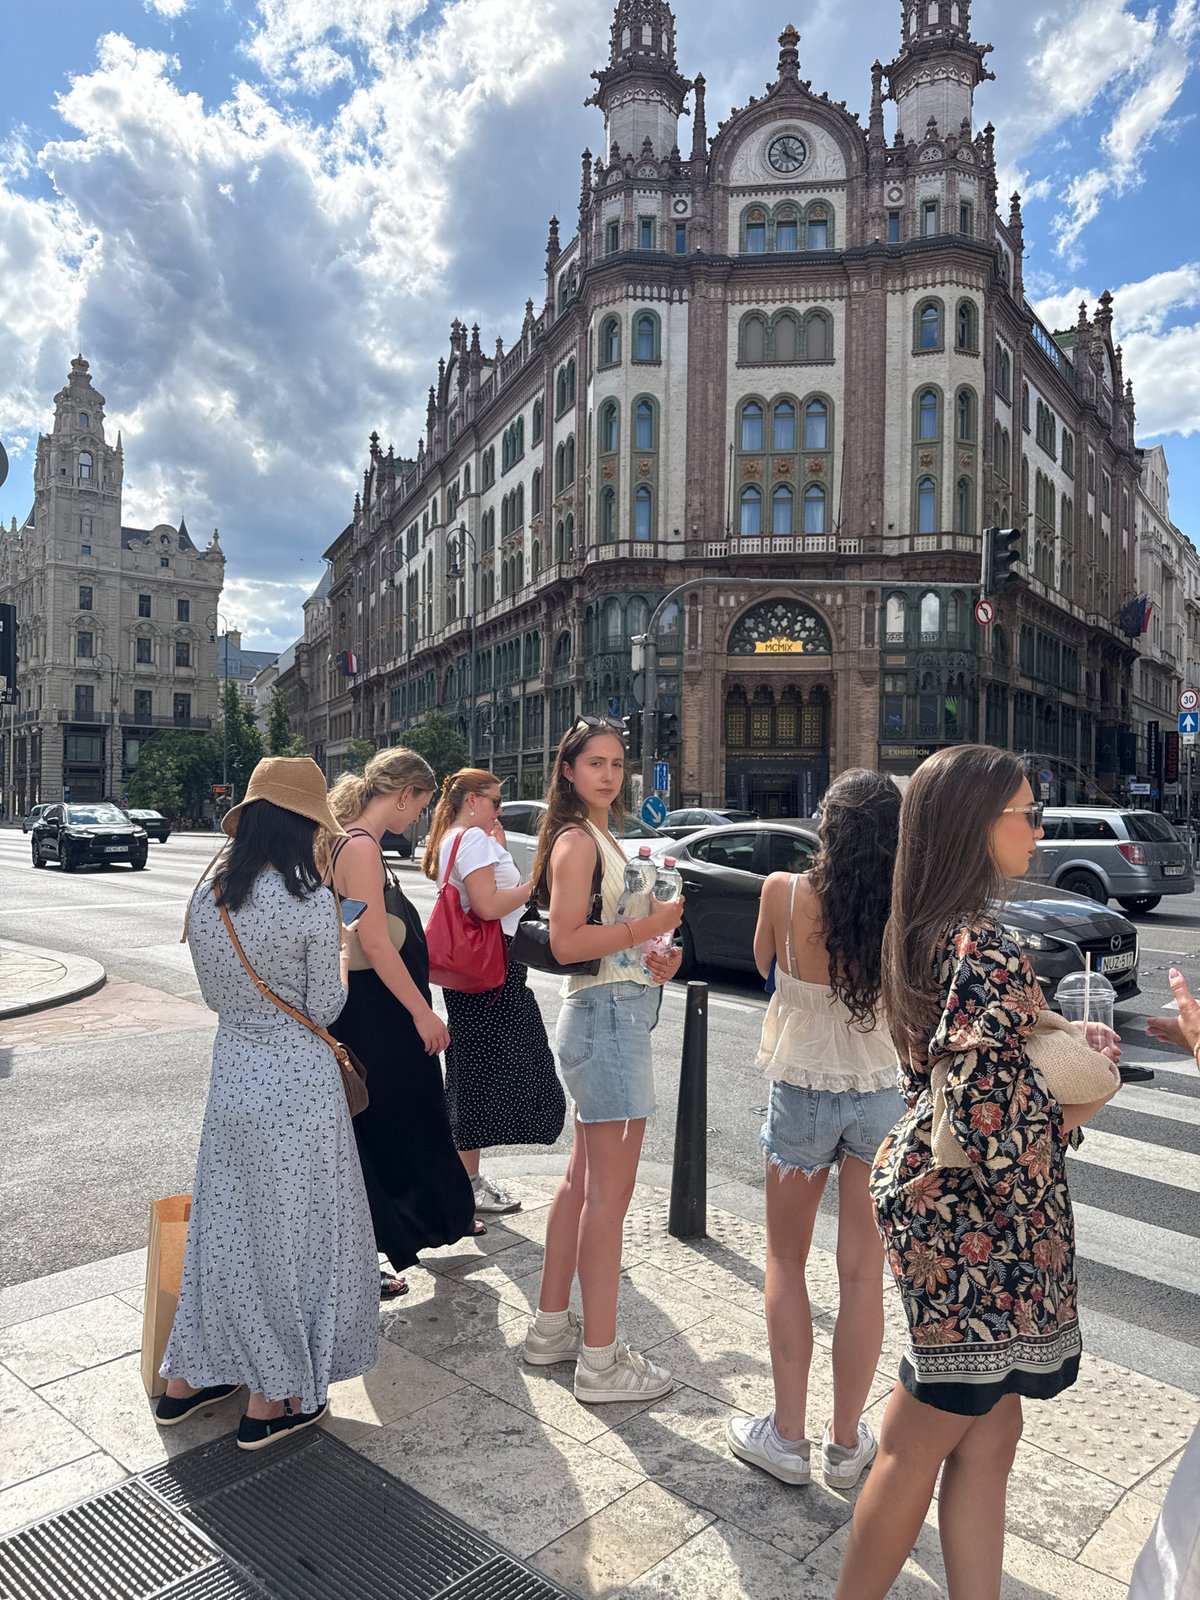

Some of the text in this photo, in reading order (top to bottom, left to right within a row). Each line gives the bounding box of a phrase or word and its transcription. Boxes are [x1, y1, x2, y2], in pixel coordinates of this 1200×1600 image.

[765, 643, 793, 652] MCMIX
[1183, 695, 1194, 704] 30
[1102, 953, 1133, 970] NUZ-517
